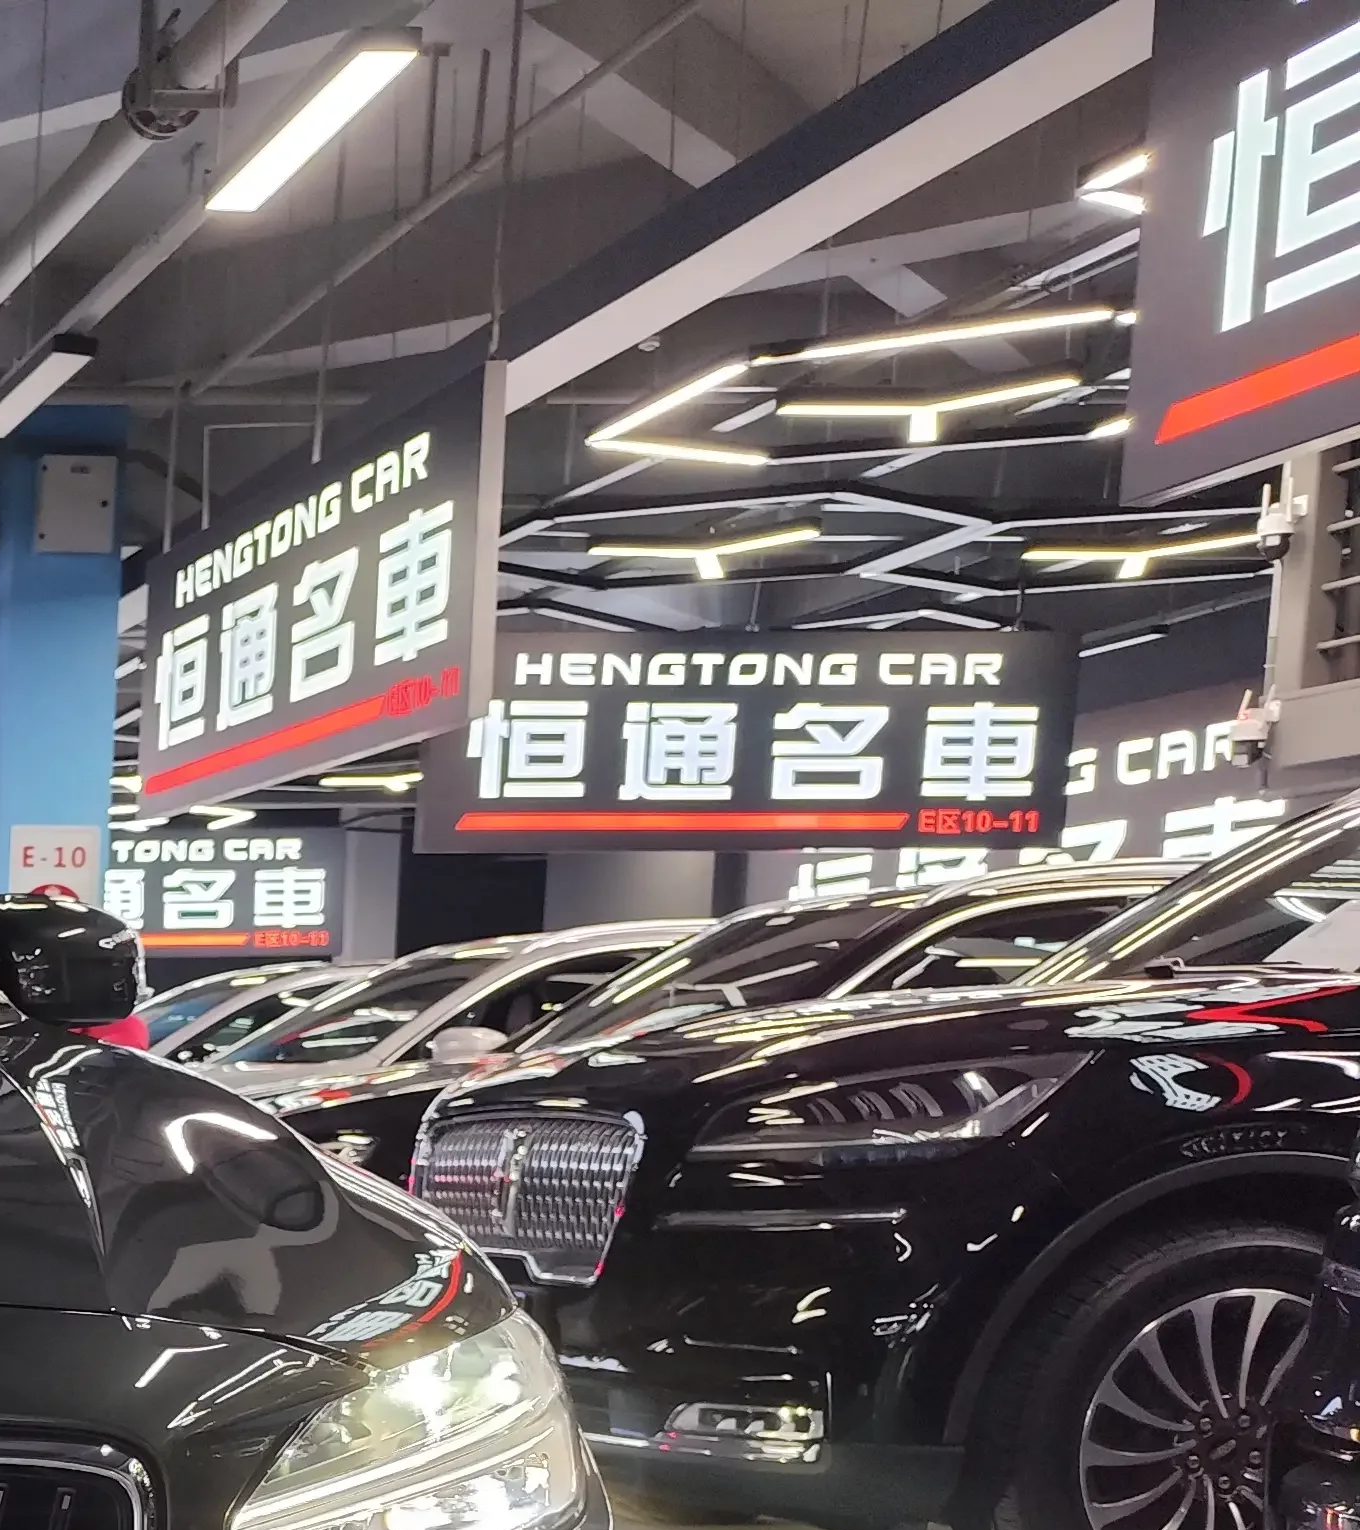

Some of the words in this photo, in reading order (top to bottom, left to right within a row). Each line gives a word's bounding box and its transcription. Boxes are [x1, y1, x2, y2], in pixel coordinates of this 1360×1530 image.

[175, 481, 343, 608] HENGTONG
[351, 431, 431, 513] CAR
[154, 500, 454, 750] 恒通名車
[515, 652, 860, 687] HENGTONG
[878, 652, 1005, 687] CAR
[466, 699, 1040, 802] 恒通名車
[917, 810, 1040, 834] E区10-11
[22, 846, 86, 868] E-10
[224, 838, 303, 861] CAR
